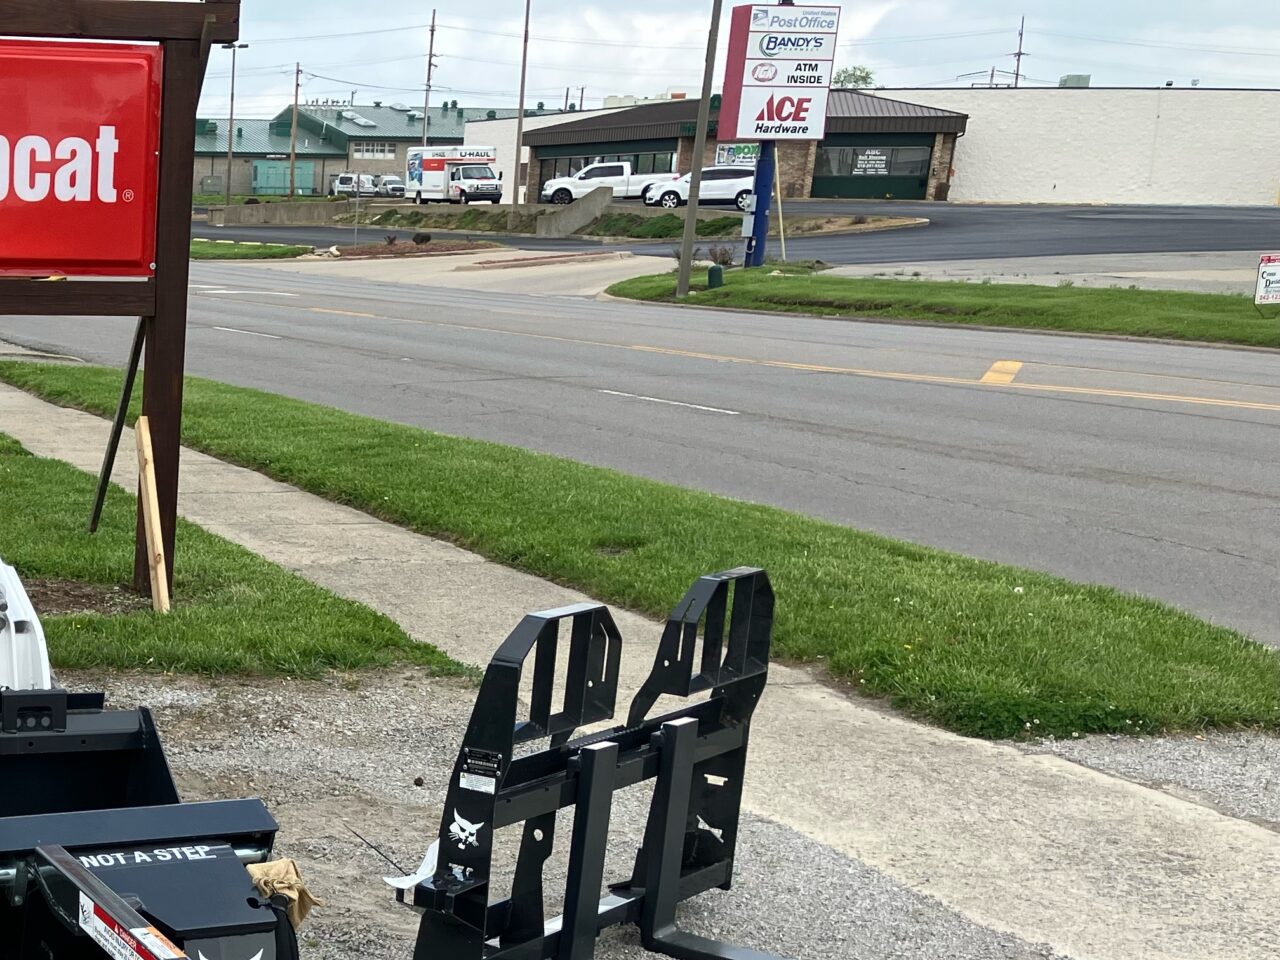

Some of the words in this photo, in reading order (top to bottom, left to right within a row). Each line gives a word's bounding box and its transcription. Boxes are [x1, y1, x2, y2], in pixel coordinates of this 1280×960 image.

[770, 16, 799, 28] Post
[799, 16, 834, 28] Office
[766, 36, 824, 50] BANDY'S
[795, 63, 818, 72] ATM
[787, 75, 822, 84] INSIDE
[755, 92, 812, 121] ACE
[755, 123, 808, 134] Hardware
[79, 853, 126, 868] NOT
[134, 851, 152, 863] A
[153, 845, 211, 860] STEP
